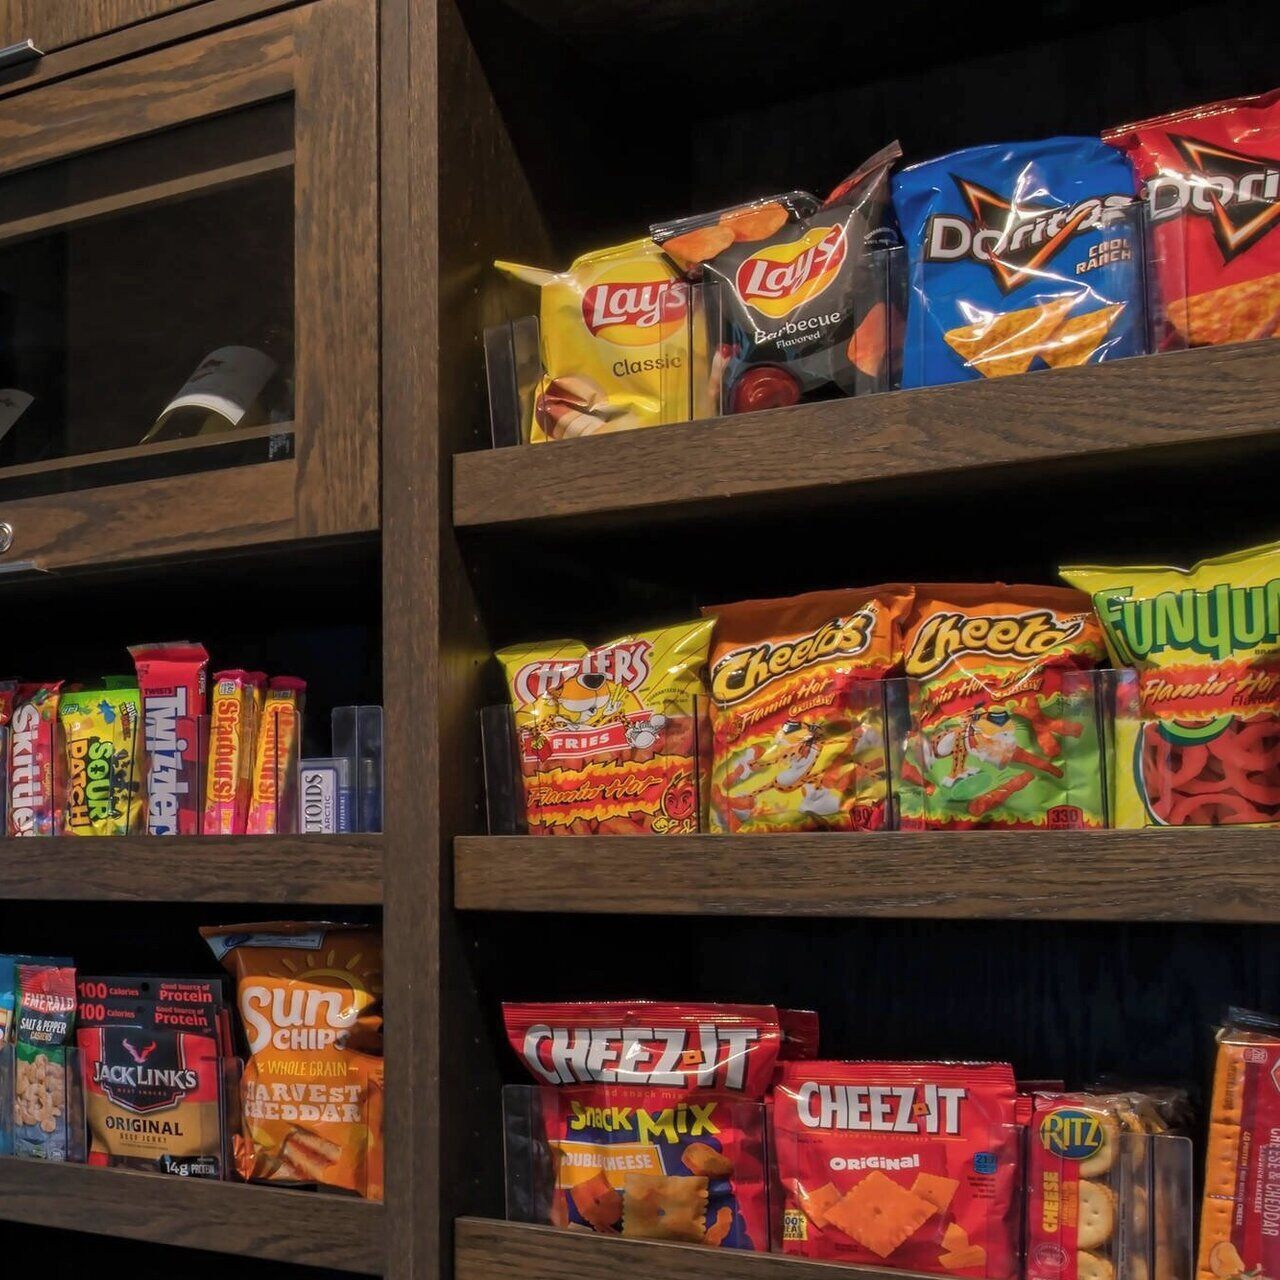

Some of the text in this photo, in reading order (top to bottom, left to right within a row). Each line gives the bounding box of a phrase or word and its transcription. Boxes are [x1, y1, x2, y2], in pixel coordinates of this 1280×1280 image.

[928, 194, 1136, 261] Doritos
[745, 225, 843, 298] Lay's
[1076, 249, 1132, 275] RANCH
[592, 276, 688, 328] Lay's
[754, 311, 842, 345] Barbecue
[776, 331, 821, 349] Flavored
[612, 353, 682, 379] Classic
[712, 609, 875, 702] Cheetos
[740, 677, 834, 729] Flamin' Hot
[1142, 673, 1280, 706] Flamin' Hot
[212, 699, 240, 802] Starburst
[552, 732, 611, 750] FRIES
[70, 738, 90, 827] PATCH
[86, 739, 113, 820] SOUR
[527, 775, 663, 807] Flamin' Hot
[1051, 809, 1079, 823] 330
[24, 992, 75, 1012] EMERALD
[78, 982, 139, 998] 100 Calories
[159, 989, 213, 1003] Protein
[78, 1003, 136, 1021] 100 Calories
[154, 1012, 208, 1026] Protein
[155, 1005, 196, 1015] Good Source
[242, 986, 357, 1054] Sun
[20, 1017, 67, 1034] SALT PEPPER
[93, 1062, 198, 1090] JACK LINK'S
[267, 1060, 347, 1076] WHOLE GRAIN
[105, 1116, 184, 1137] ORIGINAL
[571, 1100, 632, 1132] Snack
[1042, 1113, 1103, 1151] RITZ
[166, 1160, 190, 1176] 14g
[1042, 1171, 1059, 1233] CHEESE
